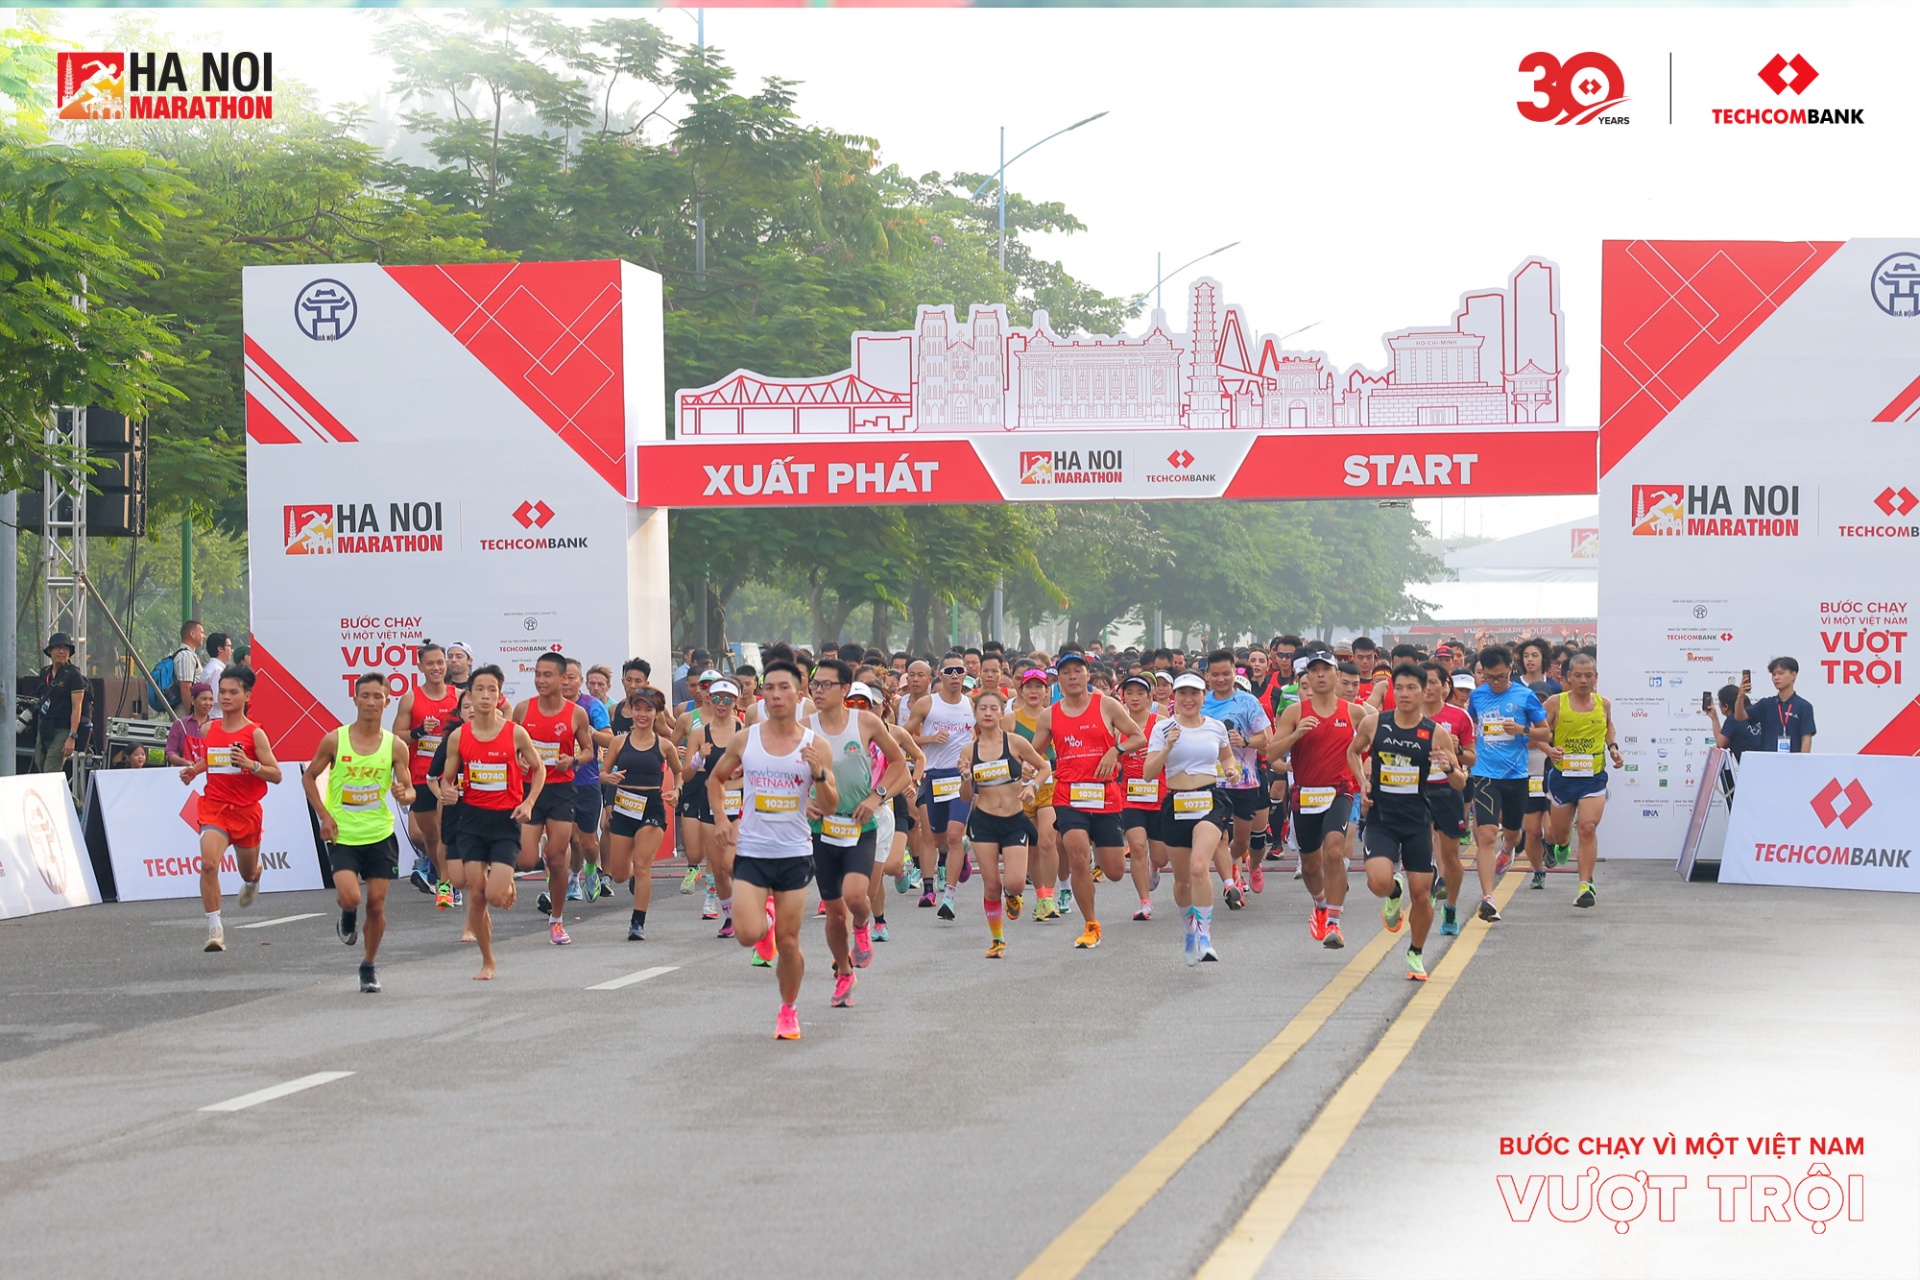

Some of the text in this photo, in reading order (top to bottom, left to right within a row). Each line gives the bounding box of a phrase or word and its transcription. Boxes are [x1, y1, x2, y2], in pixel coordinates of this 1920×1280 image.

[1054, 450, 1122, 470] HA NOI
[1343, 453, 1478, 486] START
[703, 453, 939, 496] XUẤT PHÁT
[1054, 472, 1122, 484] MARATHON
[1146, 474, 1216, 483] TECHCOMBANK
[1688, 485, 1799, 516] HA NOI
[337, 502, 442, 534] HA NOI
[1688, 518, 1799, 537] MARATHON
[338, 534, 443, 554] MARATHON
[480, 537, 588, 551] TECHCOMBANK
[1820, 599, 1908, 616] BƯỚC CHẠY
[340, 615, 422, 630] BƯỚC CHẠY
[1821, 615, 1908, 626] VÌ MỘT VIỆT NAM
[400, 631, 422, 639] NAM
[1820, 627, 1908, 657] VƯỢT
[341, 642, 422, 671] VƯỢT
[1821, 657, 1901, 689] TRỘI
[342, 670, 418, 701] TỘI
[1383, 737, 1421, 749] ANTA
[748, 776, 795, 789] VIETNAM
[143, 852, 291, 877] TECHCMNK
[1755, 843, 1912, 868] TECHCOMBANK
